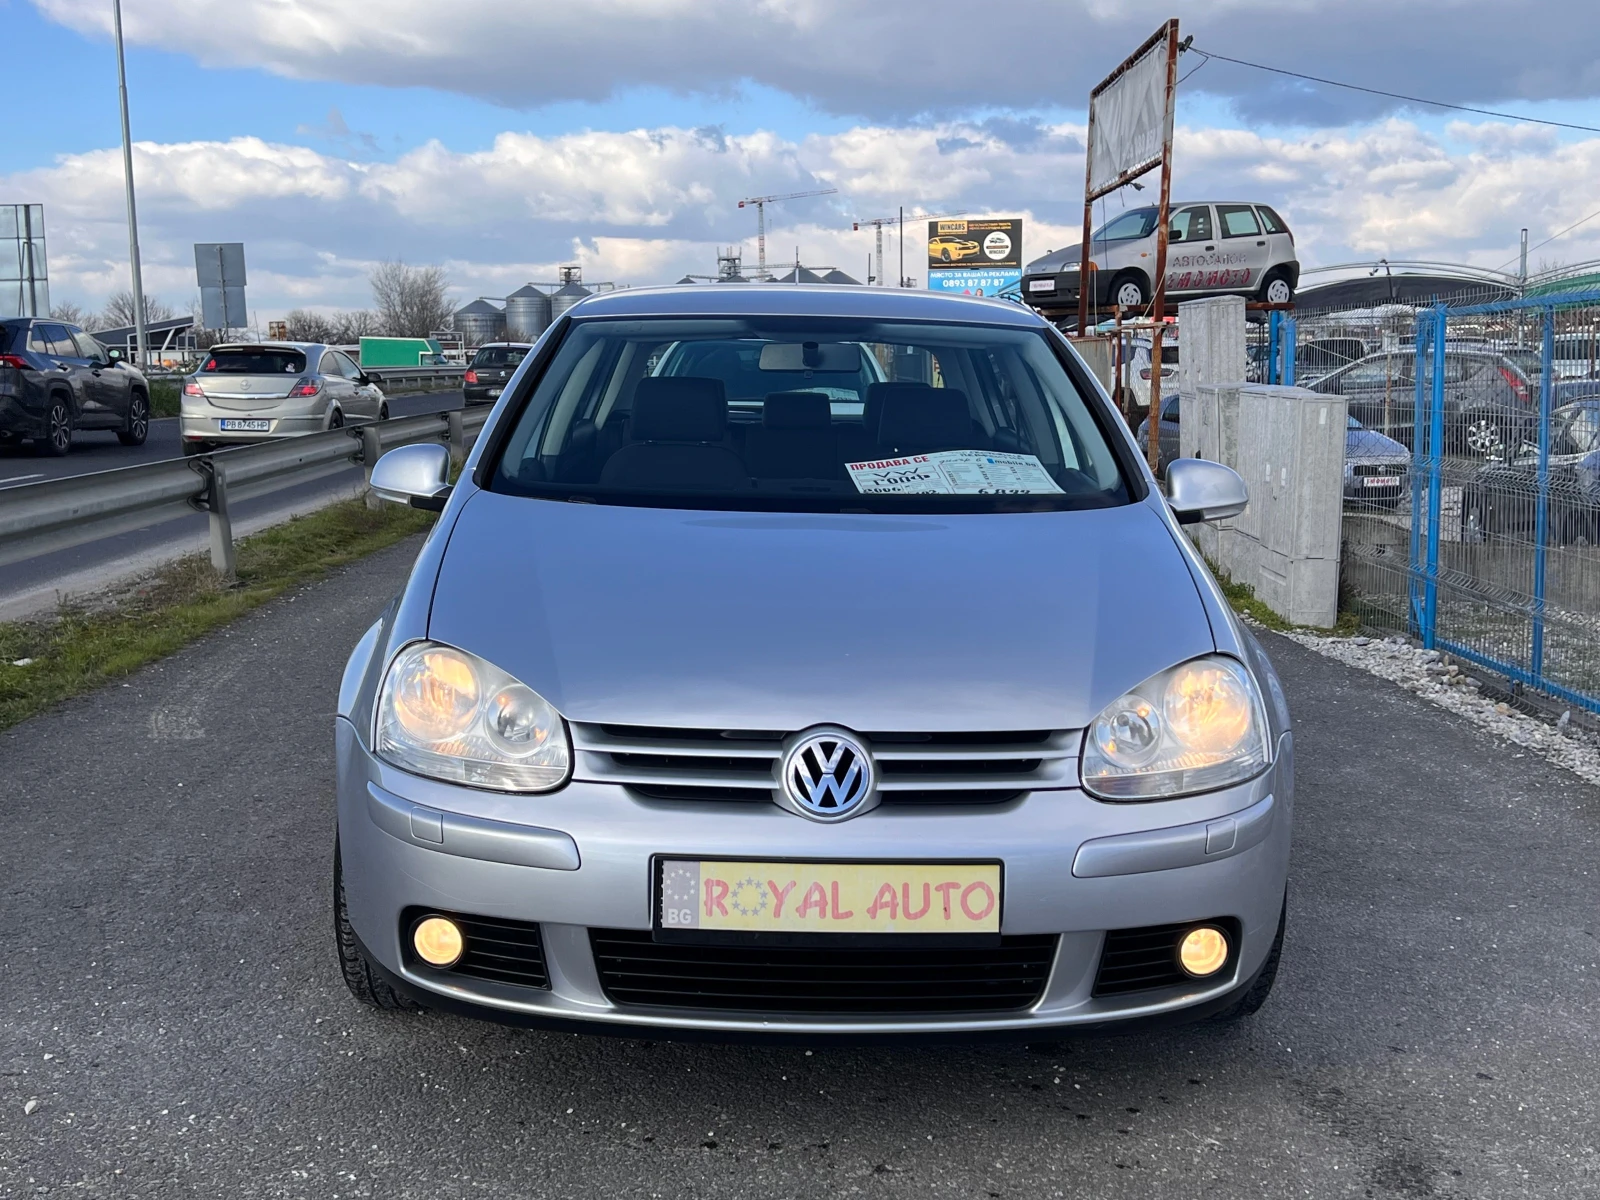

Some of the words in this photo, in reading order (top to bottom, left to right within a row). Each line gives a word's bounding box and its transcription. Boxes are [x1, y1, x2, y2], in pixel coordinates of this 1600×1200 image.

[940, 223, 966, 231] WINCARS
[967, 279, 978, 287] 87
[980, 279, 991, 287] 87
[993, 278, 1005, 286] 87
[238, 421, 255, 429] 8745
[850, 459, 911, 470] ПРОДАВА
[913, 455, 930, 464] СЕ
[703, 877, 854, 920] ROYAL
[866, 880, 996, 922] AUTO
[666, 908, 693, 925] BG
